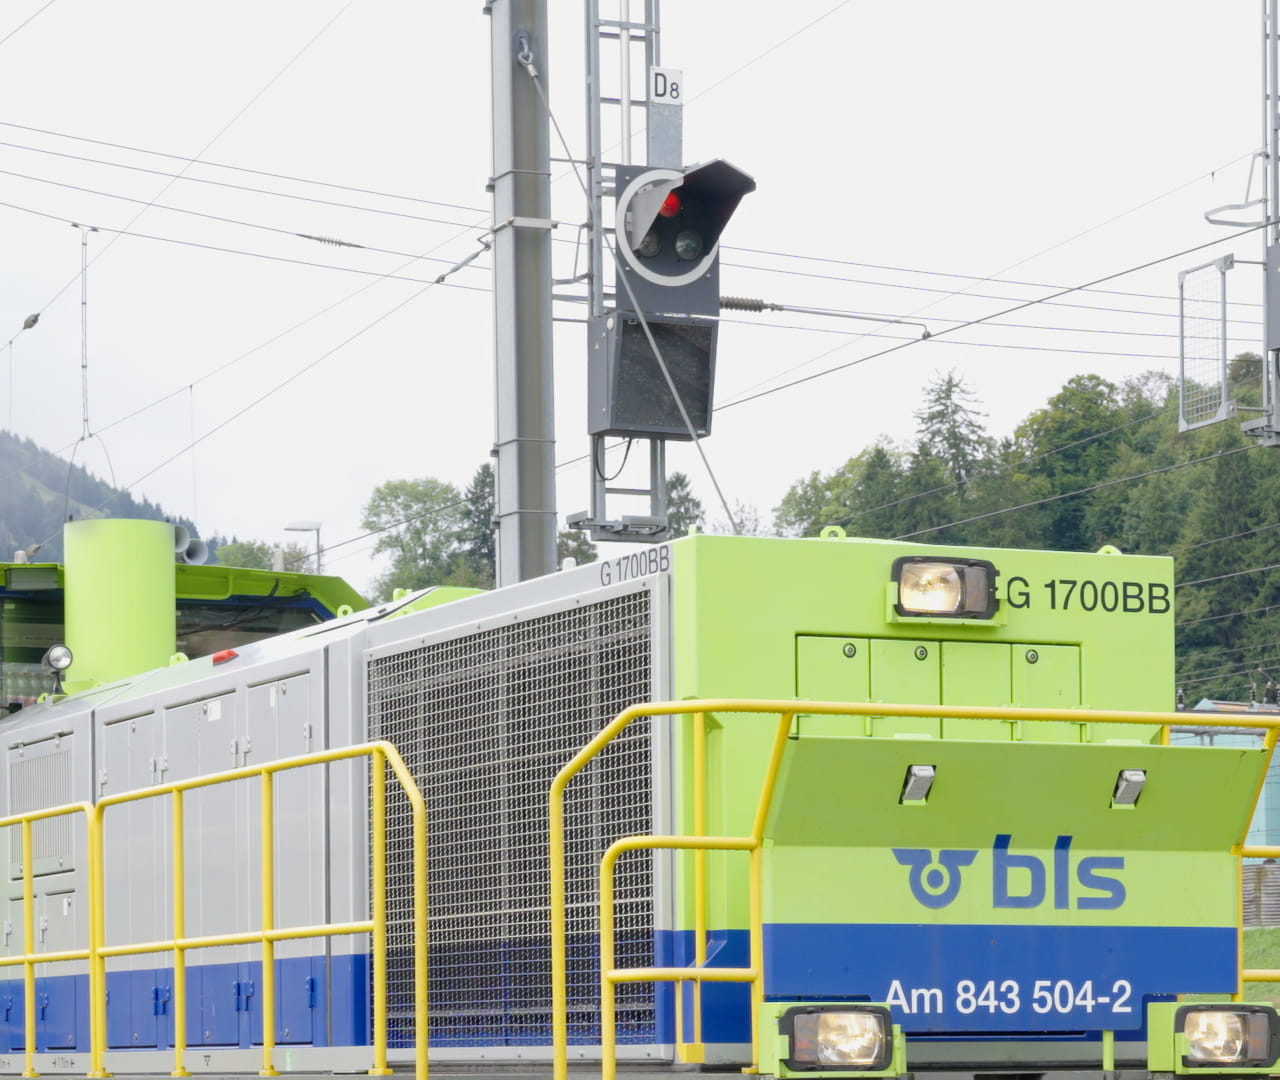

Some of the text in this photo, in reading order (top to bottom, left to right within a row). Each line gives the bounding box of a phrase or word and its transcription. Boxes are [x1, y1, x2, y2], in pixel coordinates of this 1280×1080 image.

[654, 71, 680, 99] D8
[600, 544, 670, 588] G 1700BB
[1006, 576, 1171, 614] G 1700BB
[991, 833, 1127, 911] bls
[885, 979, 1133, 1015] Am 843 504-2
